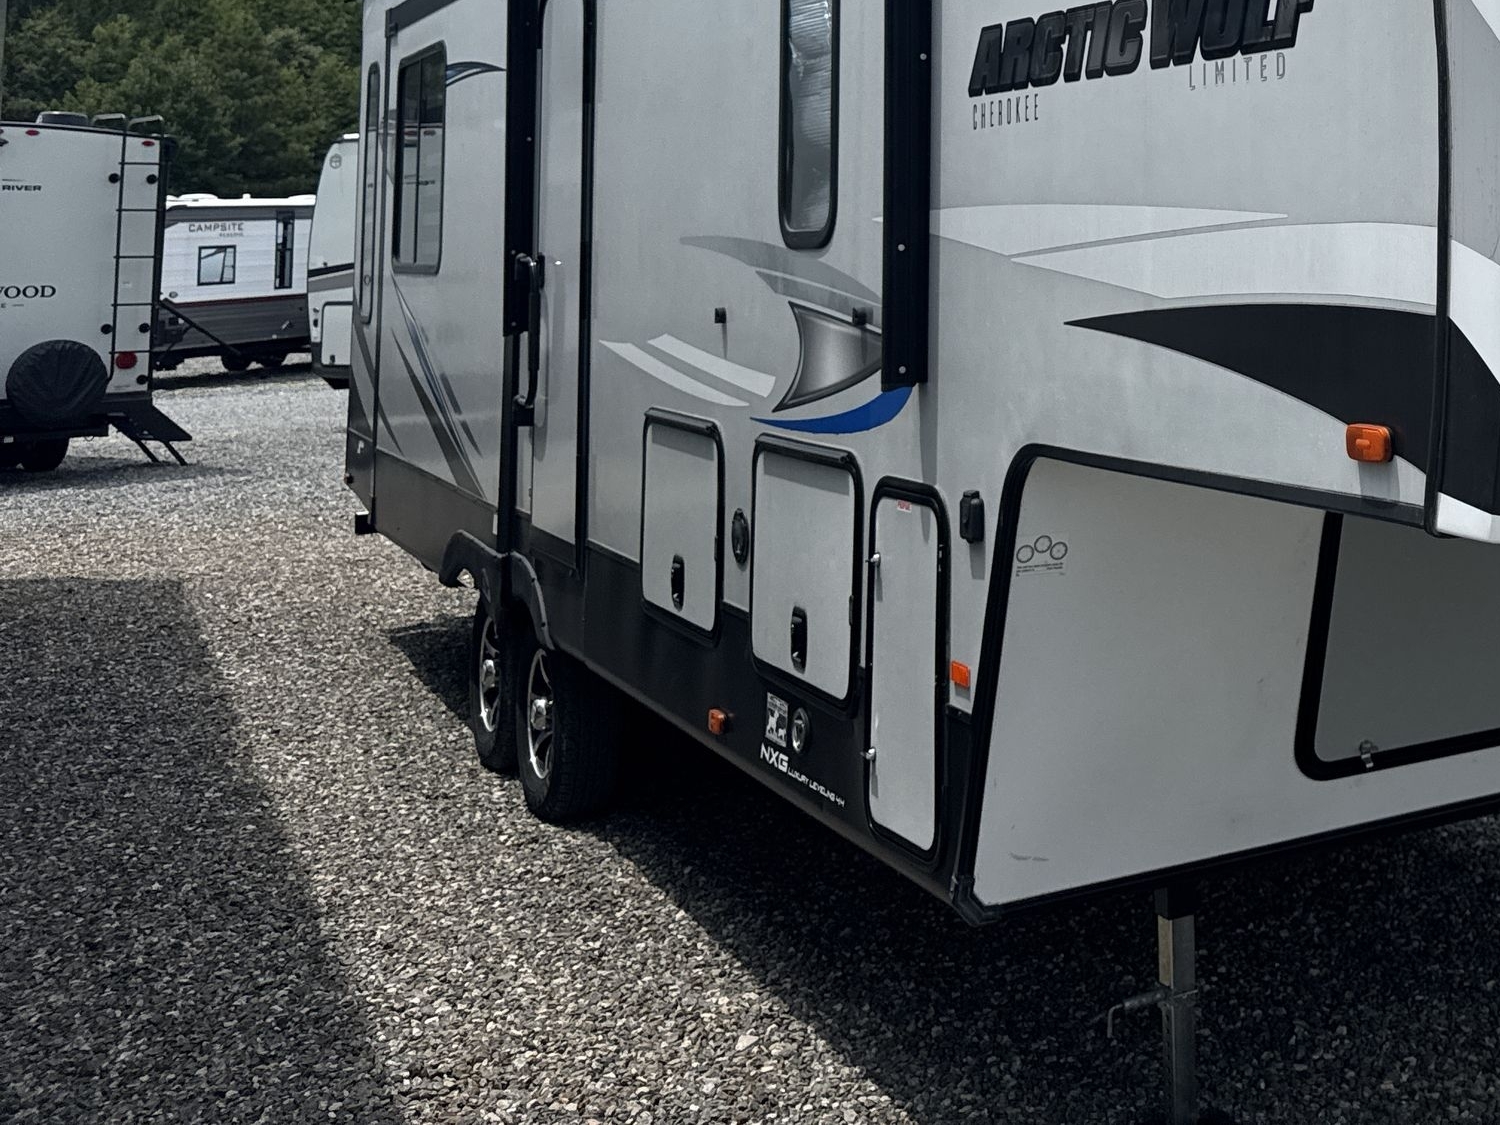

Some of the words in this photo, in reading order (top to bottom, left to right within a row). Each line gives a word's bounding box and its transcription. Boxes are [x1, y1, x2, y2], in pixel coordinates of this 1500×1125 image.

[1188, 51, 1287, 91] LIMITED
[972, 93, 1040, 131] CHEROKEE
[188, 222, 244, 233] CAMPSITE
[760, 743, 789, 773] NXG
